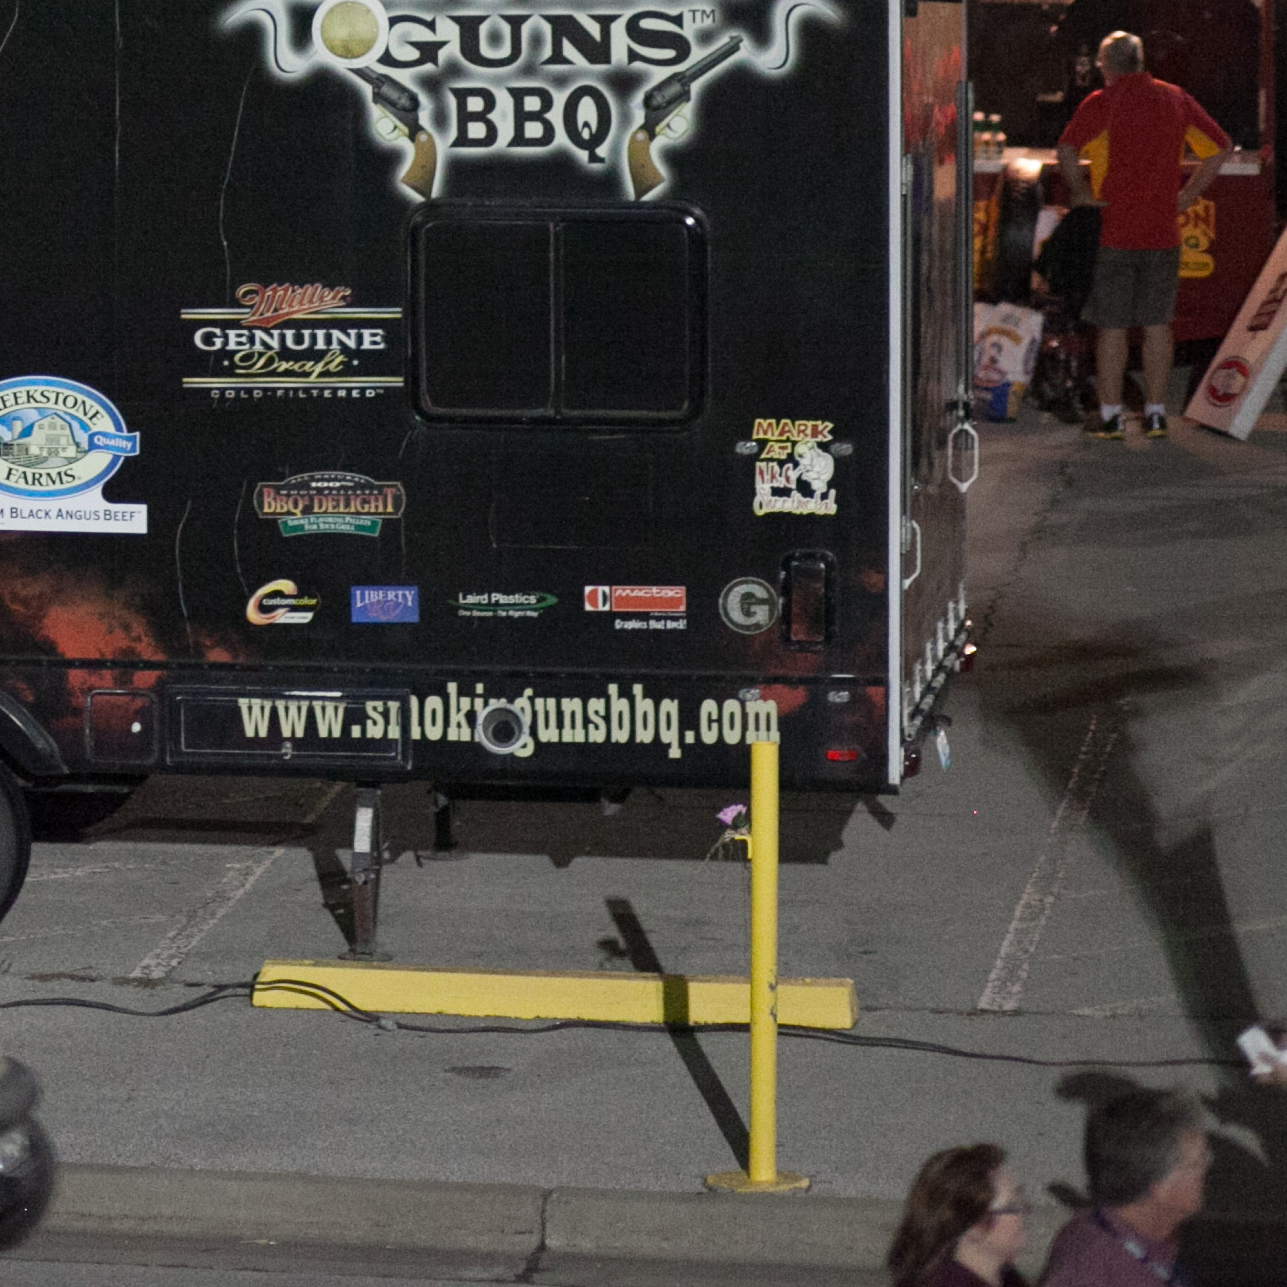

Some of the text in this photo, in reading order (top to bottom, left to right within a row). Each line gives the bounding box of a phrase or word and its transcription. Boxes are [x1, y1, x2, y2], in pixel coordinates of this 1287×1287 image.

[449, 83, 612, 164] BBQ
[236, 282, 352, 327] Miller
[194, 327, 386, 351] GENUINE
[233, 348, 348, 381] Draft
[753, 419, 834, 441] MARK
[93, 434, 133, 451] Quality
[760, 441, 792, 459] AT
[4, 466, 76, 488] FARMS
[312, 487, 397, 514] DELIGHT
[10, 506, 52, 520] BLACK
[55, 508, 100, 521] ANGUS
[355, 589, 416, 608] LIBERTY
[458, 591, 538, 605] Laird Plastics
[727, 583, 770, 626] G
[237, 681, 781, 759] www.smokigunsbbq.com
